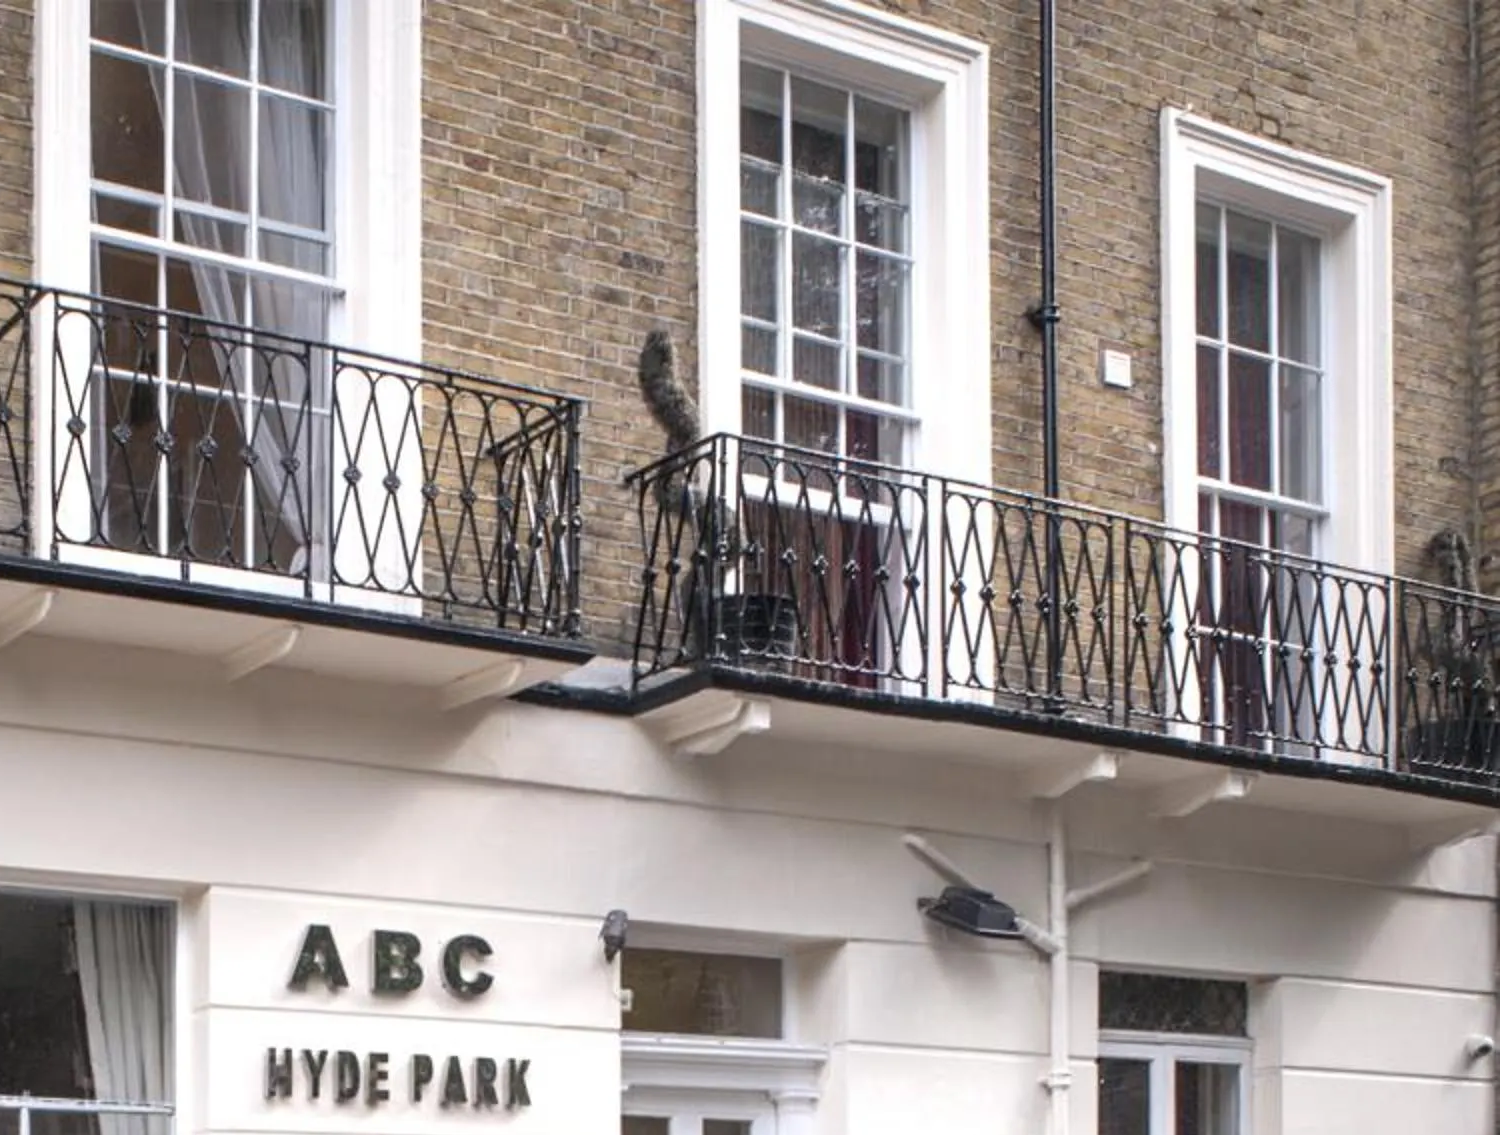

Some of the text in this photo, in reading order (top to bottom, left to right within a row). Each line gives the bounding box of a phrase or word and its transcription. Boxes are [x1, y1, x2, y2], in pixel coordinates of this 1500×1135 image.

[287, 924, 495, 1001] ABC
[263, 1048, 532, 1110] HYDE PARK
